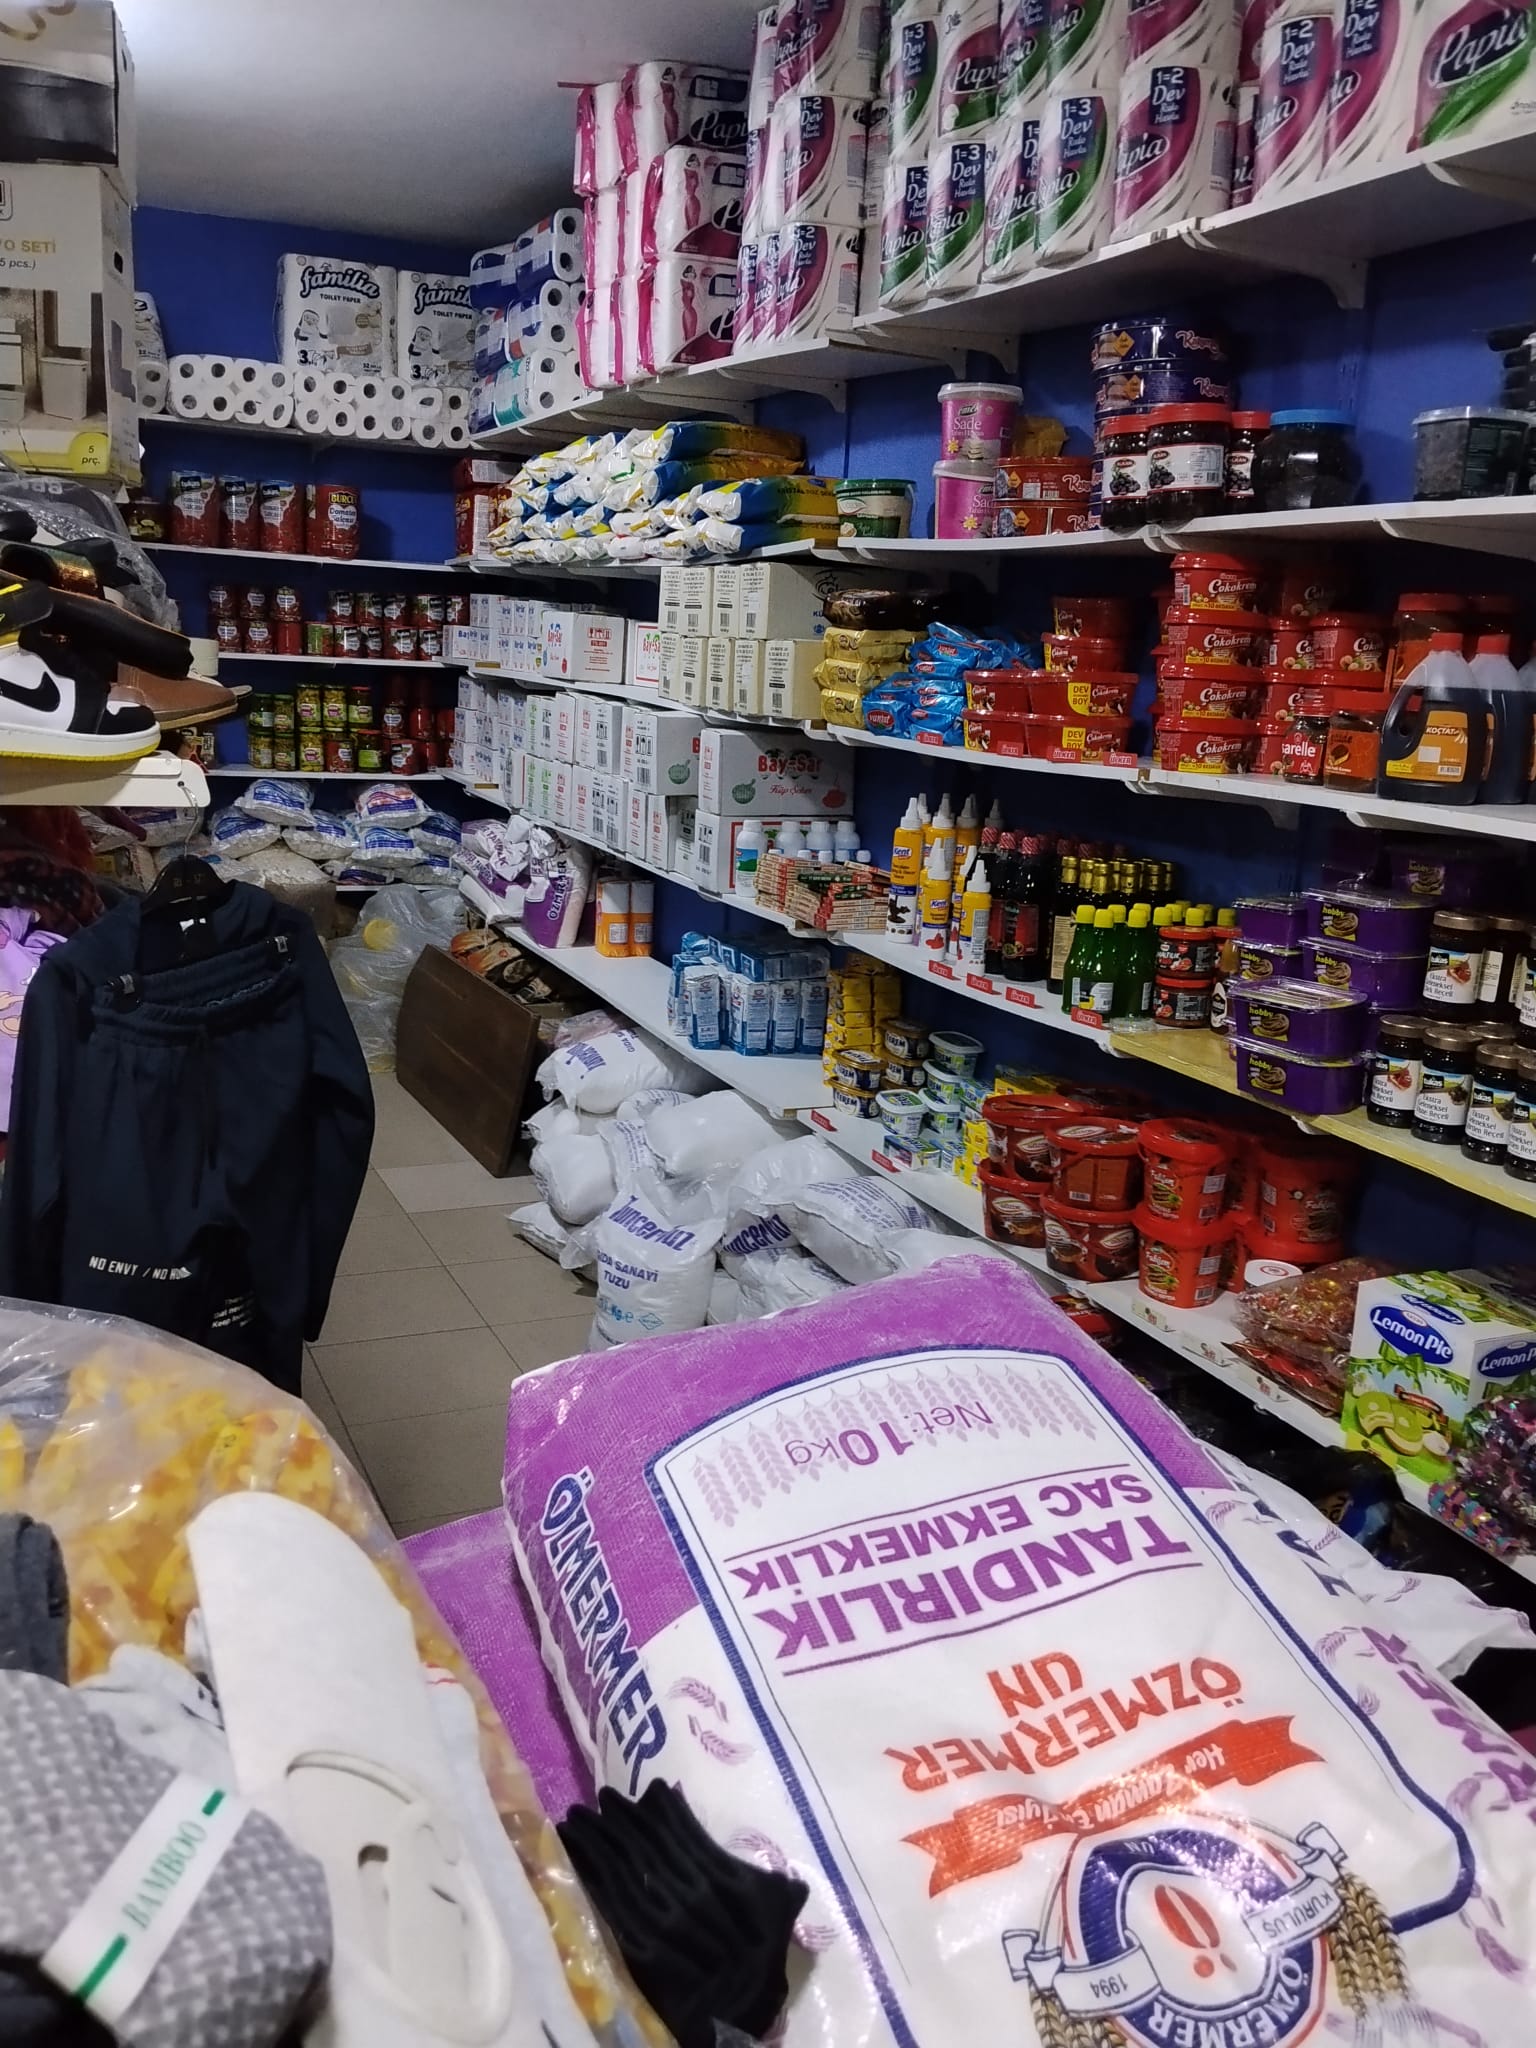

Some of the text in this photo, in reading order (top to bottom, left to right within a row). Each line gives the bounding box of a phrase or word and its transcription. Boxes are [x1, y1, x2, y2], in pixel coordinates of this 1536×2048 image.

[1285, 20, 1314, 39] 1=2
[1346, 11, 1379, 36] Dev
[1281, 40, 1315, 63] Dev
[1434, 9, 1527, 86] Papia
[953, 58, 1000, 90] Papi
[1157, 67, 1185, 84] 1=2
[1064, 99, 1092, 115] 1=3
[1153, 84, 1186, 105] Dev
[690, 110, 750, 147] Papi
[800, 111, 824, 127] Dev
[1061, 117, 1093, 140] Dev
[955, 145, 981, 161] 1=3
[952, 162, 982, 182] Dev
[300, 265, 380, 299] familia
[953, 416, 983, 432] Sade
[1073, 685, 1090, 694] DEV
[1067, 730, 1084, 739] DEV
[1248, 1007, 1275, 1018] hobby
[1249, 1058, 1272, 1071] hobby
[89, 1255, 107, 1271] NO
[108, 1260, 139, 1277] ENVY
[152, 1267, 169, 1280] NO
[603, 1269, 631, 1290] TUZU
[614, 1258, 659, 1283] SANAYİ
[1372, 1308, 1426, 1350] Lemon
[1425, 1333, 1453, 1360] Pie
[1480, 1351, 1527, 1373] Lemon
[729, 1472, 1155, 1600] SAC EKMEKLİK
[753, 1514, 1193, 1662] TANDIRLIK
[540, 1465, 668, 1799] ÖZMERMER
[988, 1651, 1085, 1718] UN
[883, 1657, 1244, 1793] ÖZMERMER
[1185, 1743, 1226, 1775] Her
[121, 1820, 208, 1932] BAMBOO
[1261, 1888, 1337, 1940] KURULUŞ
[1088, 1972, 1131, 2000] 1994
[1147, 1955, 1309, 2048] ÖZMERMER
